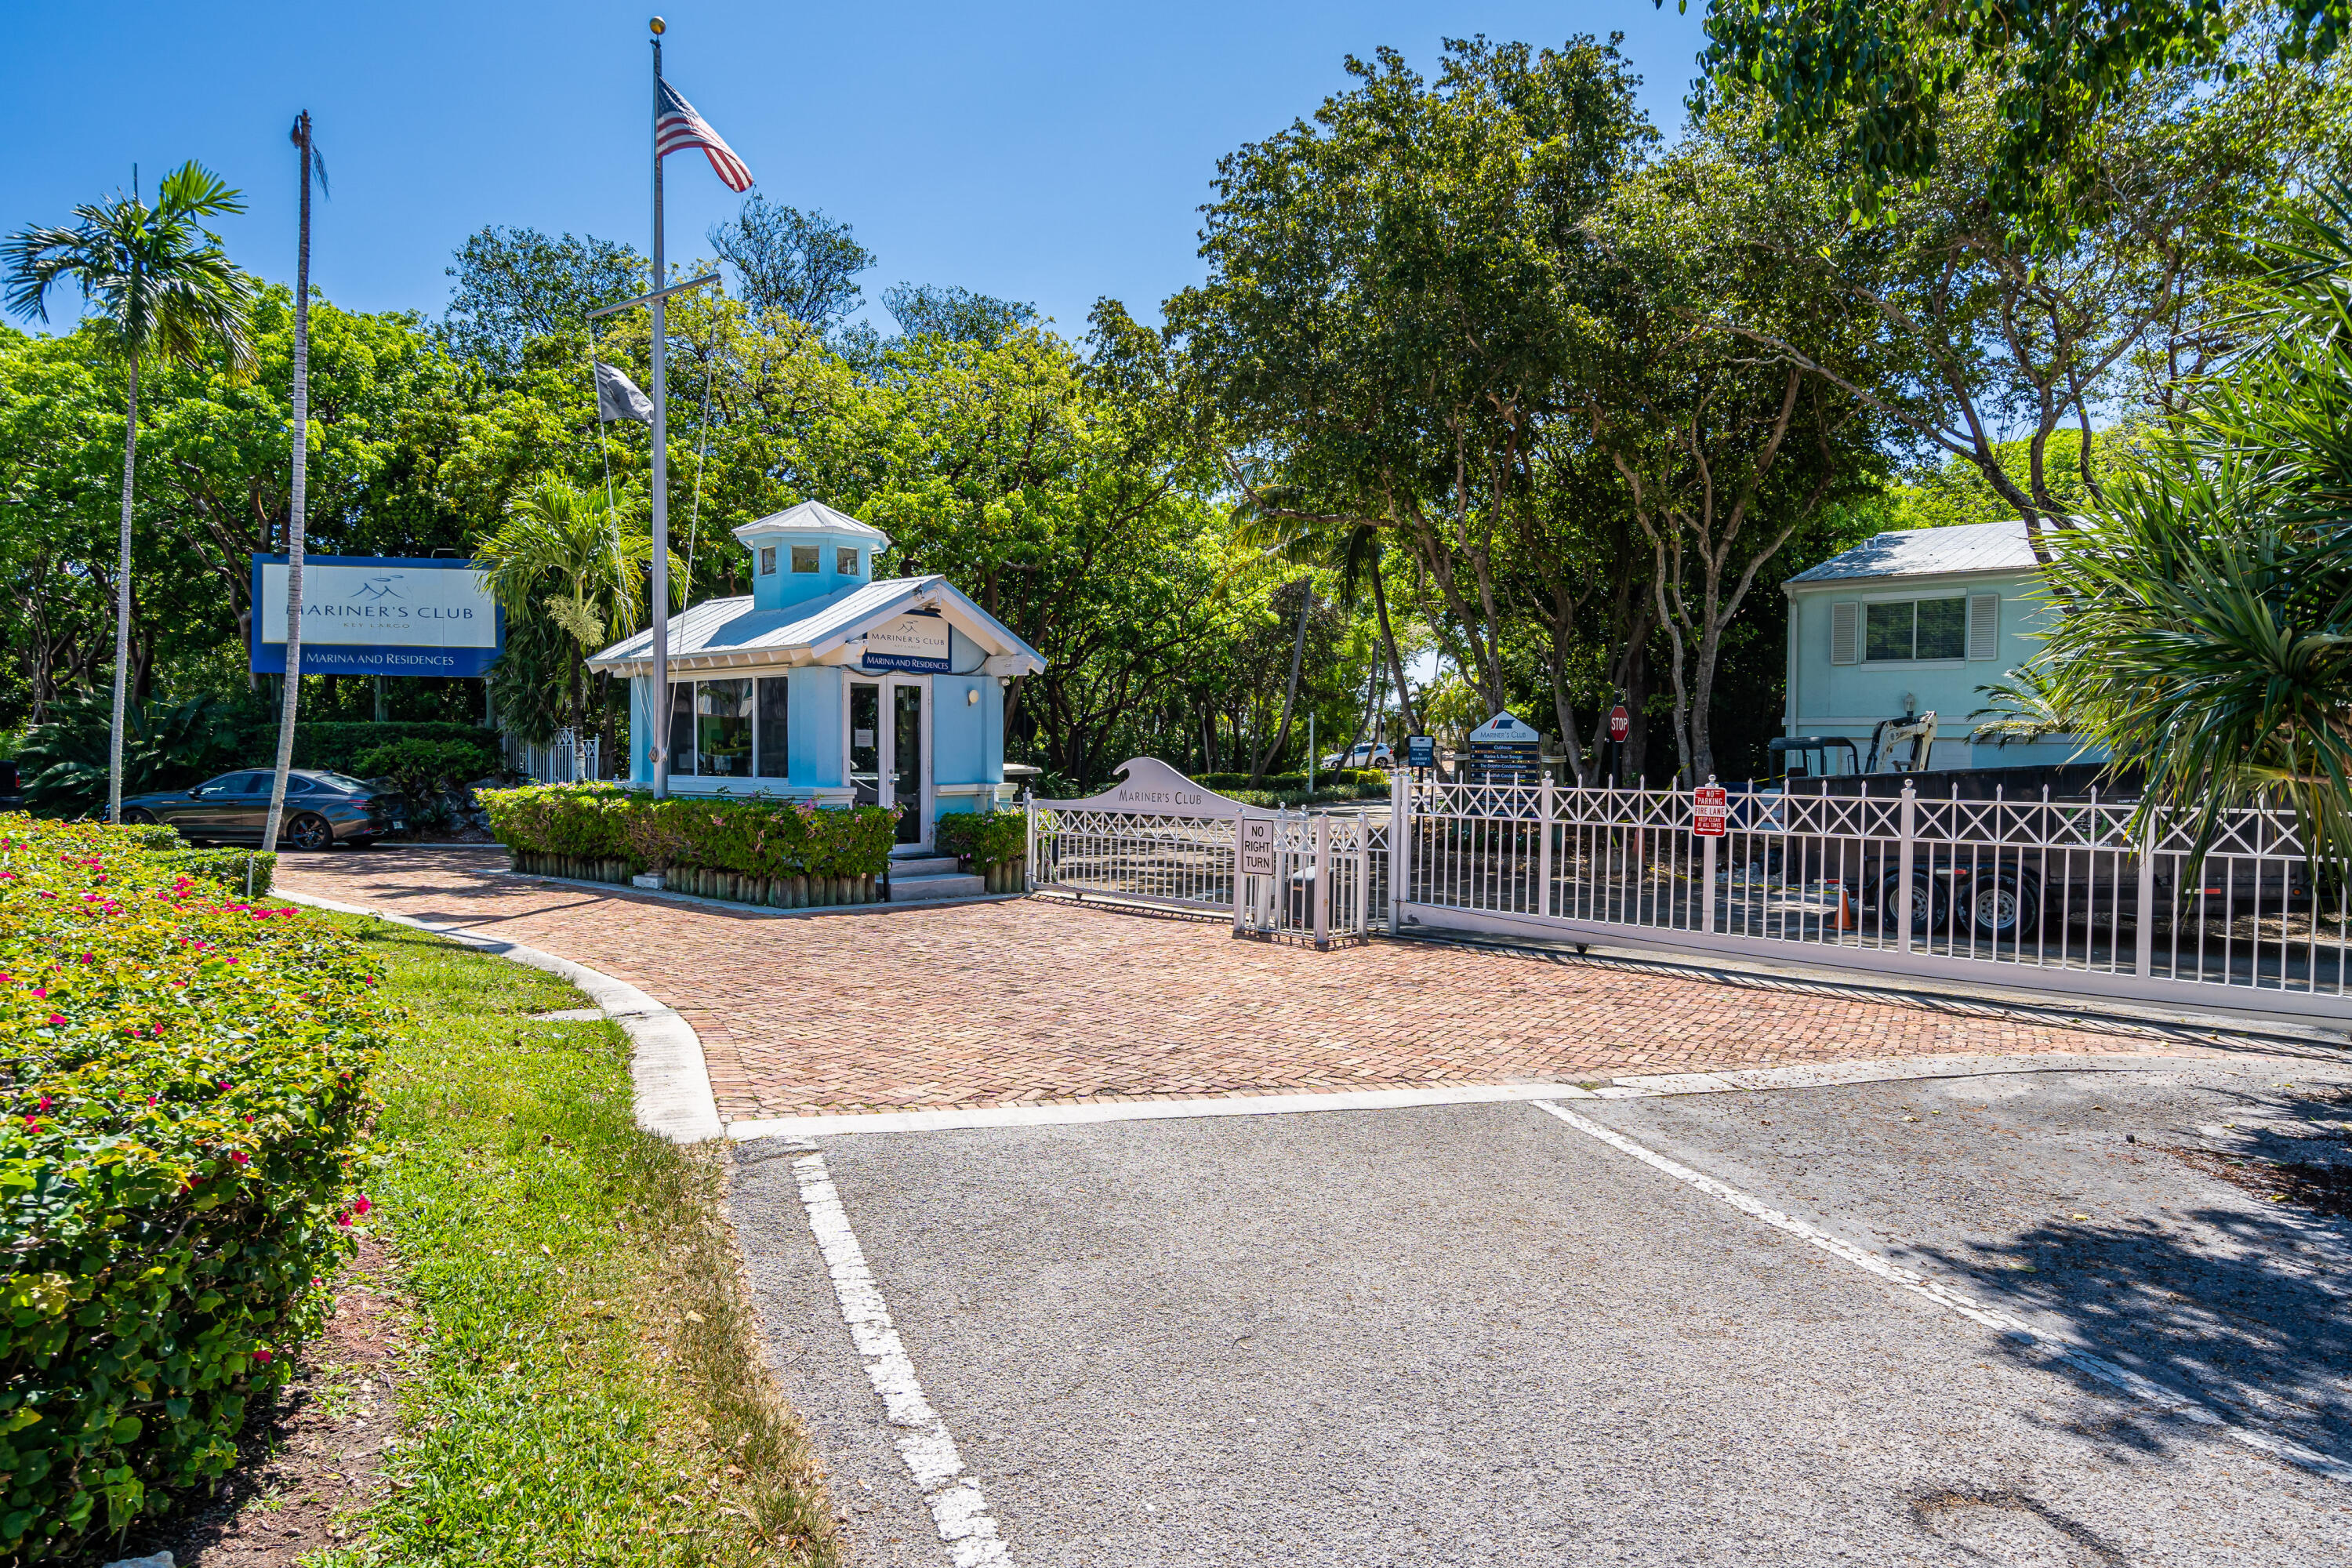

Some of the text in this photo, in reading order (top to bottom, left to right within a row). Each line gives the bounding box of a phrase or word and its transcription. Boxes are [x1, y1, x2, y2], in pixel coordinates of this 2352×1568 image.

[417, 607, 473, 619] CLUB
[871, 633, 945, 646] MARINER'S CLUB
[306, 652, 455, 666] MARINA AND RESIDENCES
[866, 655, 949, 670] MARINA AND RESIDENCES
[1611, 717, 1628, 731] STOP
[1119, 789, 1202, 805] MARINER'S CLUB
[1695, 807, 1725, 816] FIRE LANE
[1251, 825, 1265, 838] NO
[1244, 840, 1271, 855] RIGHT
[1246, 855, 1270, 869] TURN
